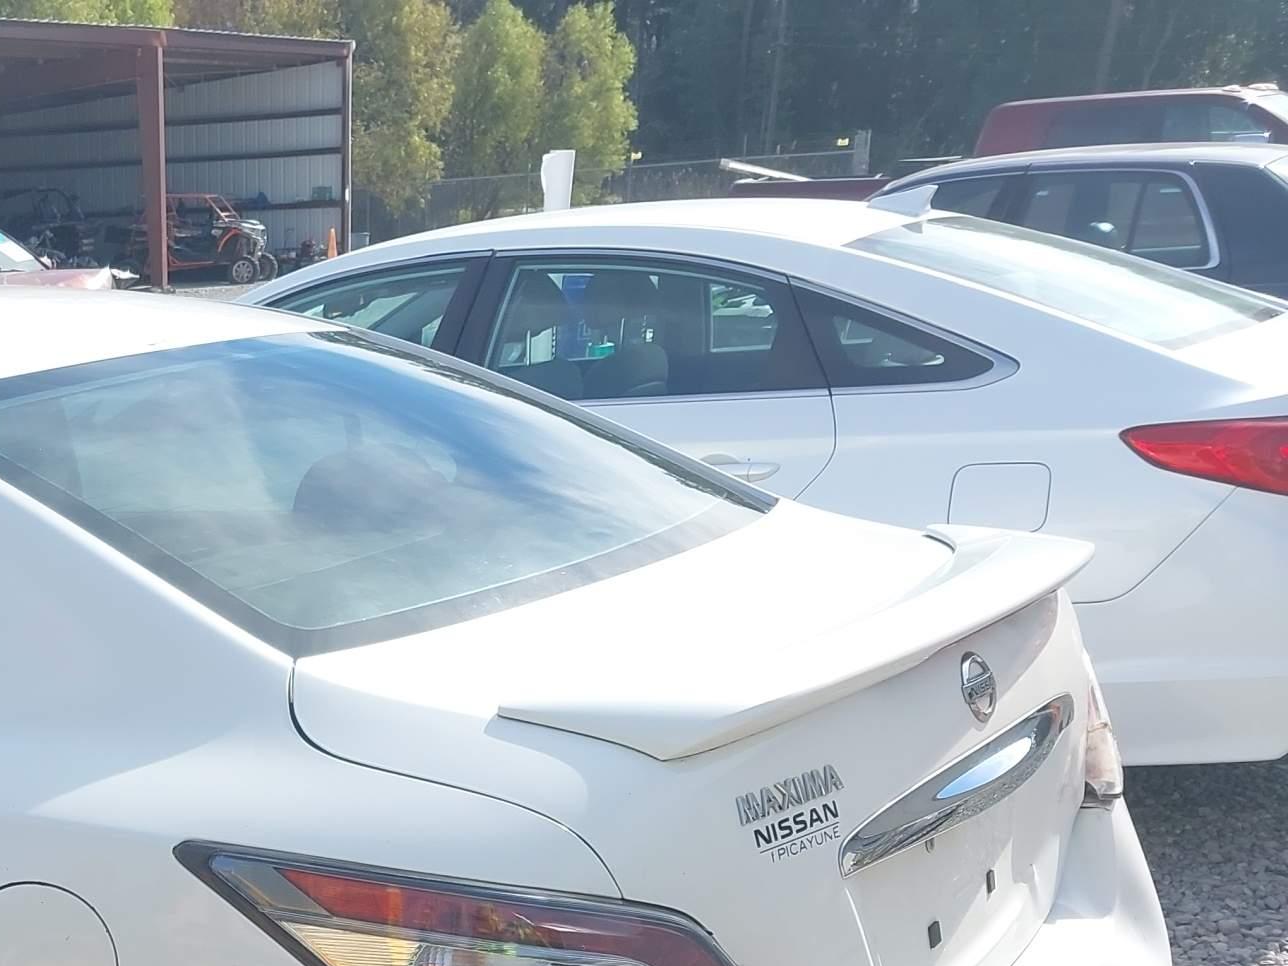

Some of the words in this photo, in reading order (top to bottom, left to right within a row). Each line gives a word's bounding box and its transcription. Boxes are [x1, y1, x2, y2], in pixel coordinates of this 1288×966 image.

[735, 764, 844, 826] MAXIMA
[753, 800, 839, 848] NISSAN
[777, 825, 841, 860] PICAYUNE
